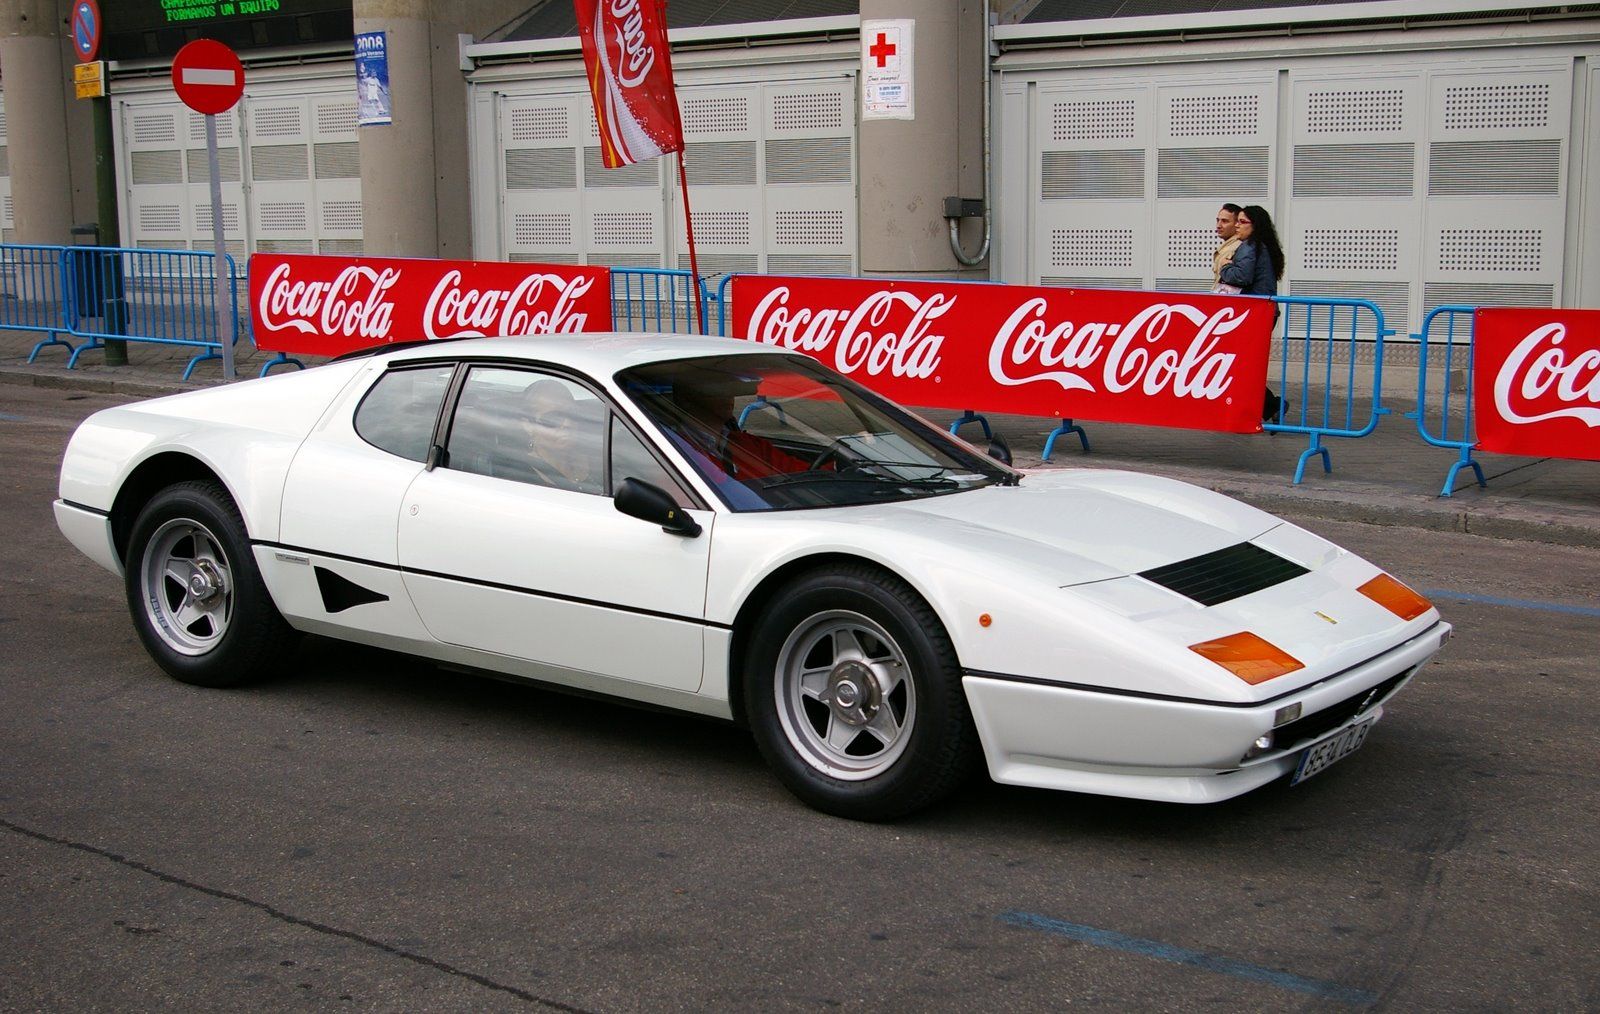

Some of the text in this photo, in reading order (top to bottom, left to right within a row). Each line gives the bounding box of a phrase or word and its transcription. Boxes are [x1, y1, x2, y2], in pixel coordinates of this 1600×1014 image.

[166, 0, 280, 21] FORMAMOS UN EQUIPO
[357, 36, 384, 50] 2008
[260, 263, 595, 341] Coca-Cola Coca-Cola
[747, 286, 1250, 400] Coca-Cola Coca-Cola
